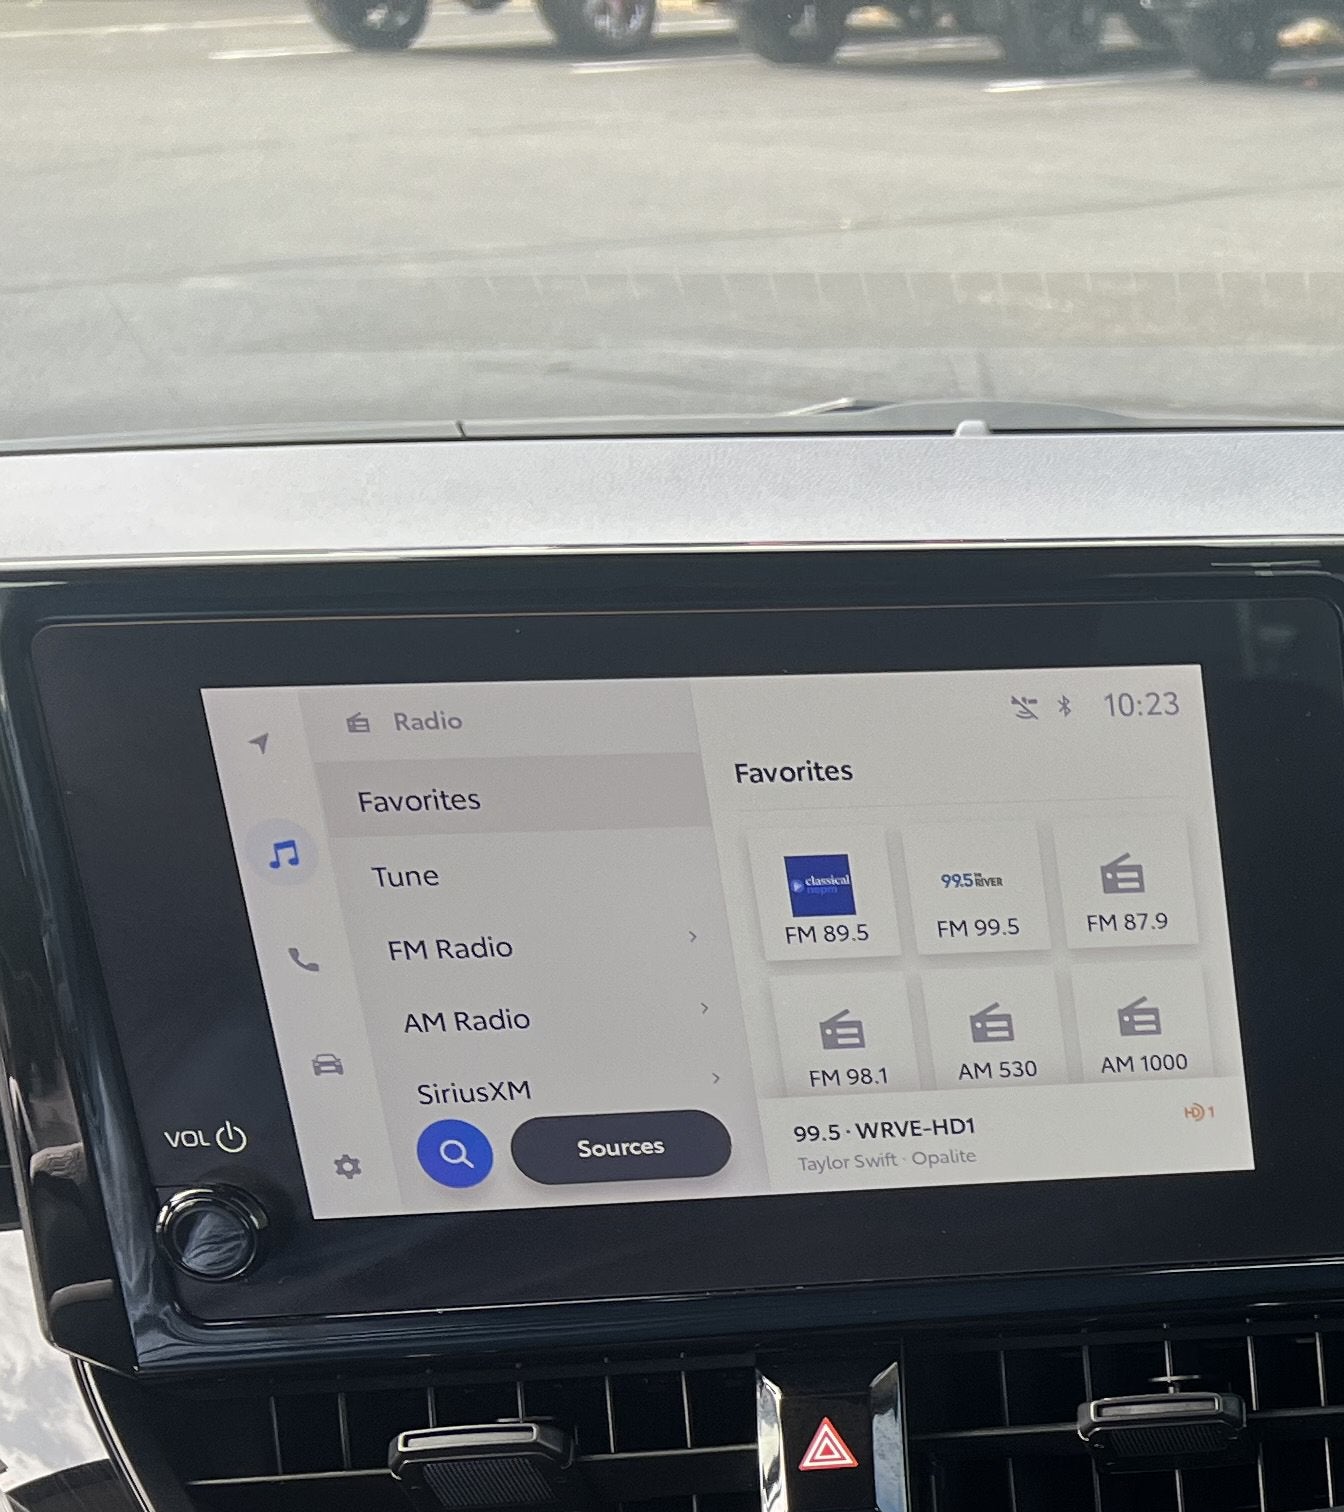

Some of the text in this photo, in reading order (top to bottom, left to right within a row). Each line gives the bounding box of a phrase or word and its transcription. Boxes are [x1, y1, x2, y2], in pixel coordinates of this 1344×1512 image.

[1103, 691, 1180, 716] 10:23
[394, 711, 463, 731] Radio
[734, 761, 854, 783] Favorites
[358, 789, 481, 813] Favorites
[371, 866, 439, 887] Tune
[805, 874, 850, 886] classical
[941, 873, 974, 888] 99.5
[937, 918, 1020, 938] FM 99.5
[1087, 911, 1168, 933] FM 87.9
[785, 924, 869, 944] FM 89.5
[388, 937, 513, 961] FM Radio
[404, 1009, 530, 1033] AM Radio
[958, 1060, 1038, 1080] AM 530
[1100, 1053, 1188, 1074] AM 1000
[809, 1067, 888, 1087] FM 98.1
[417, 1081, 532, 1105] SiriusXM
[164, 1129, 211, 1148] VOL
[793, 1118, 976, 1142] 99.5 WRVE-HD1
[577, 1138, 665, 1158] Sources
[798, 1149, 977, 1173] Taylor Swift Opalite
